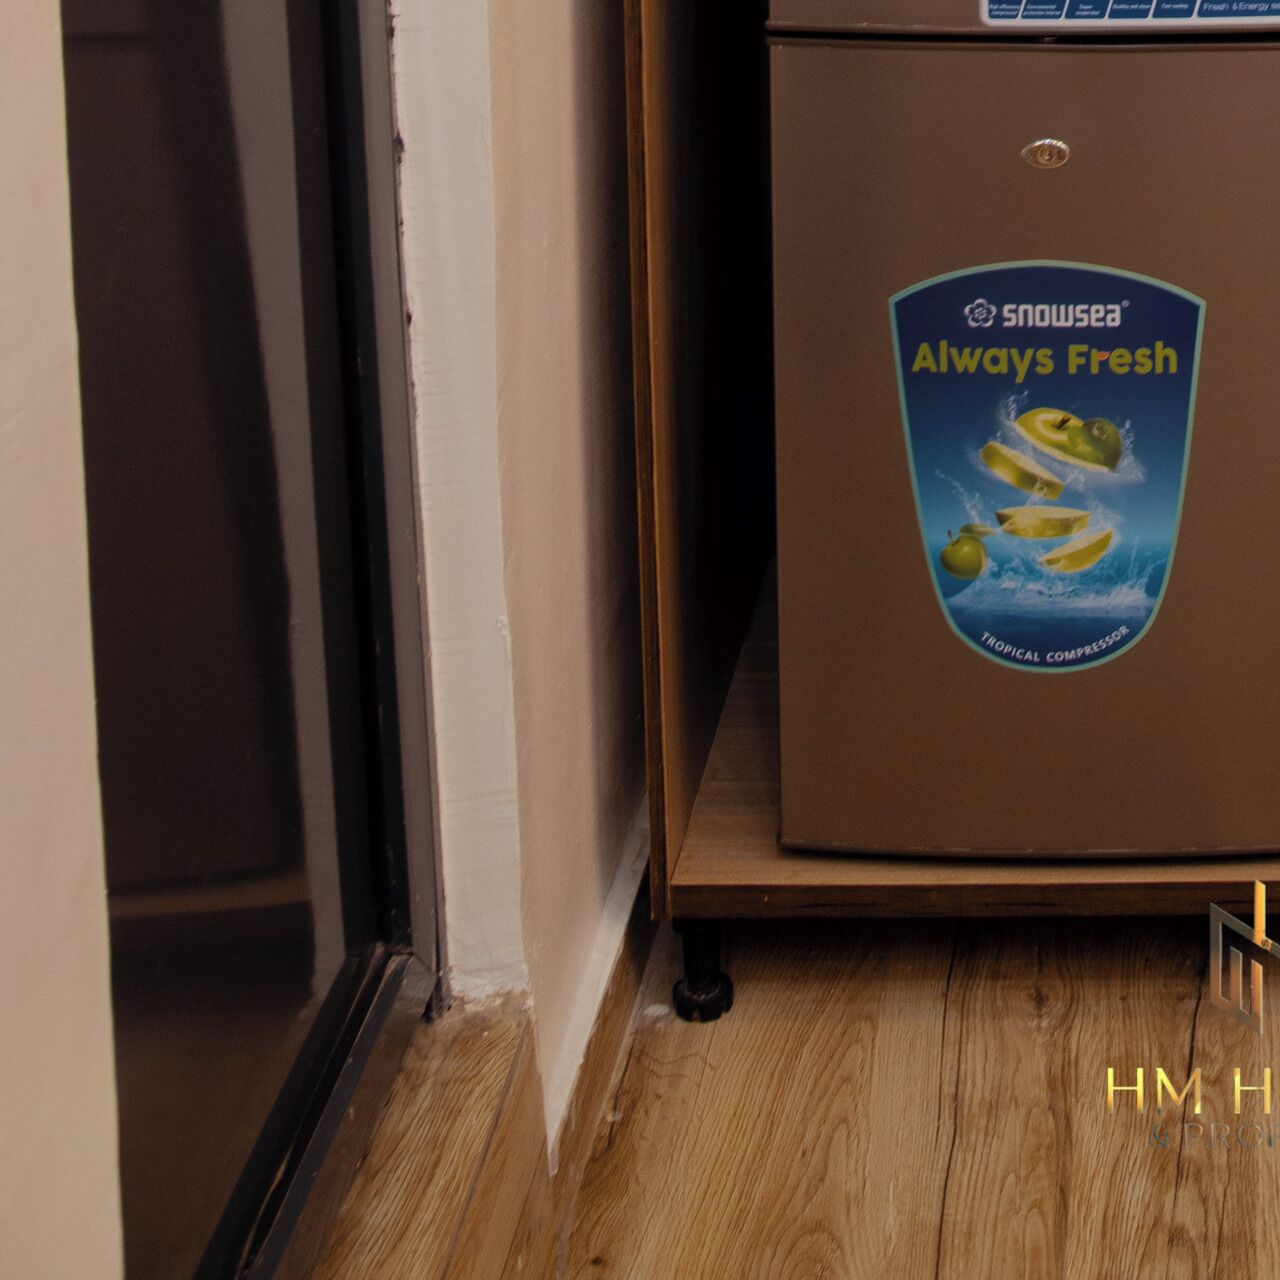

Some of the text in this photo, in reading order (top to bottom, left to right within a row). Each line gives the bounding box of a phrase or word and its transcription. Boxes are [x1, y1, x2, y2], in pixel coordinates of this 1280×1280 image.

[912, 340, 1178, 384] Always Fresh
[980, 625, 1130, 662] TROPICAL COMPRESSOR
